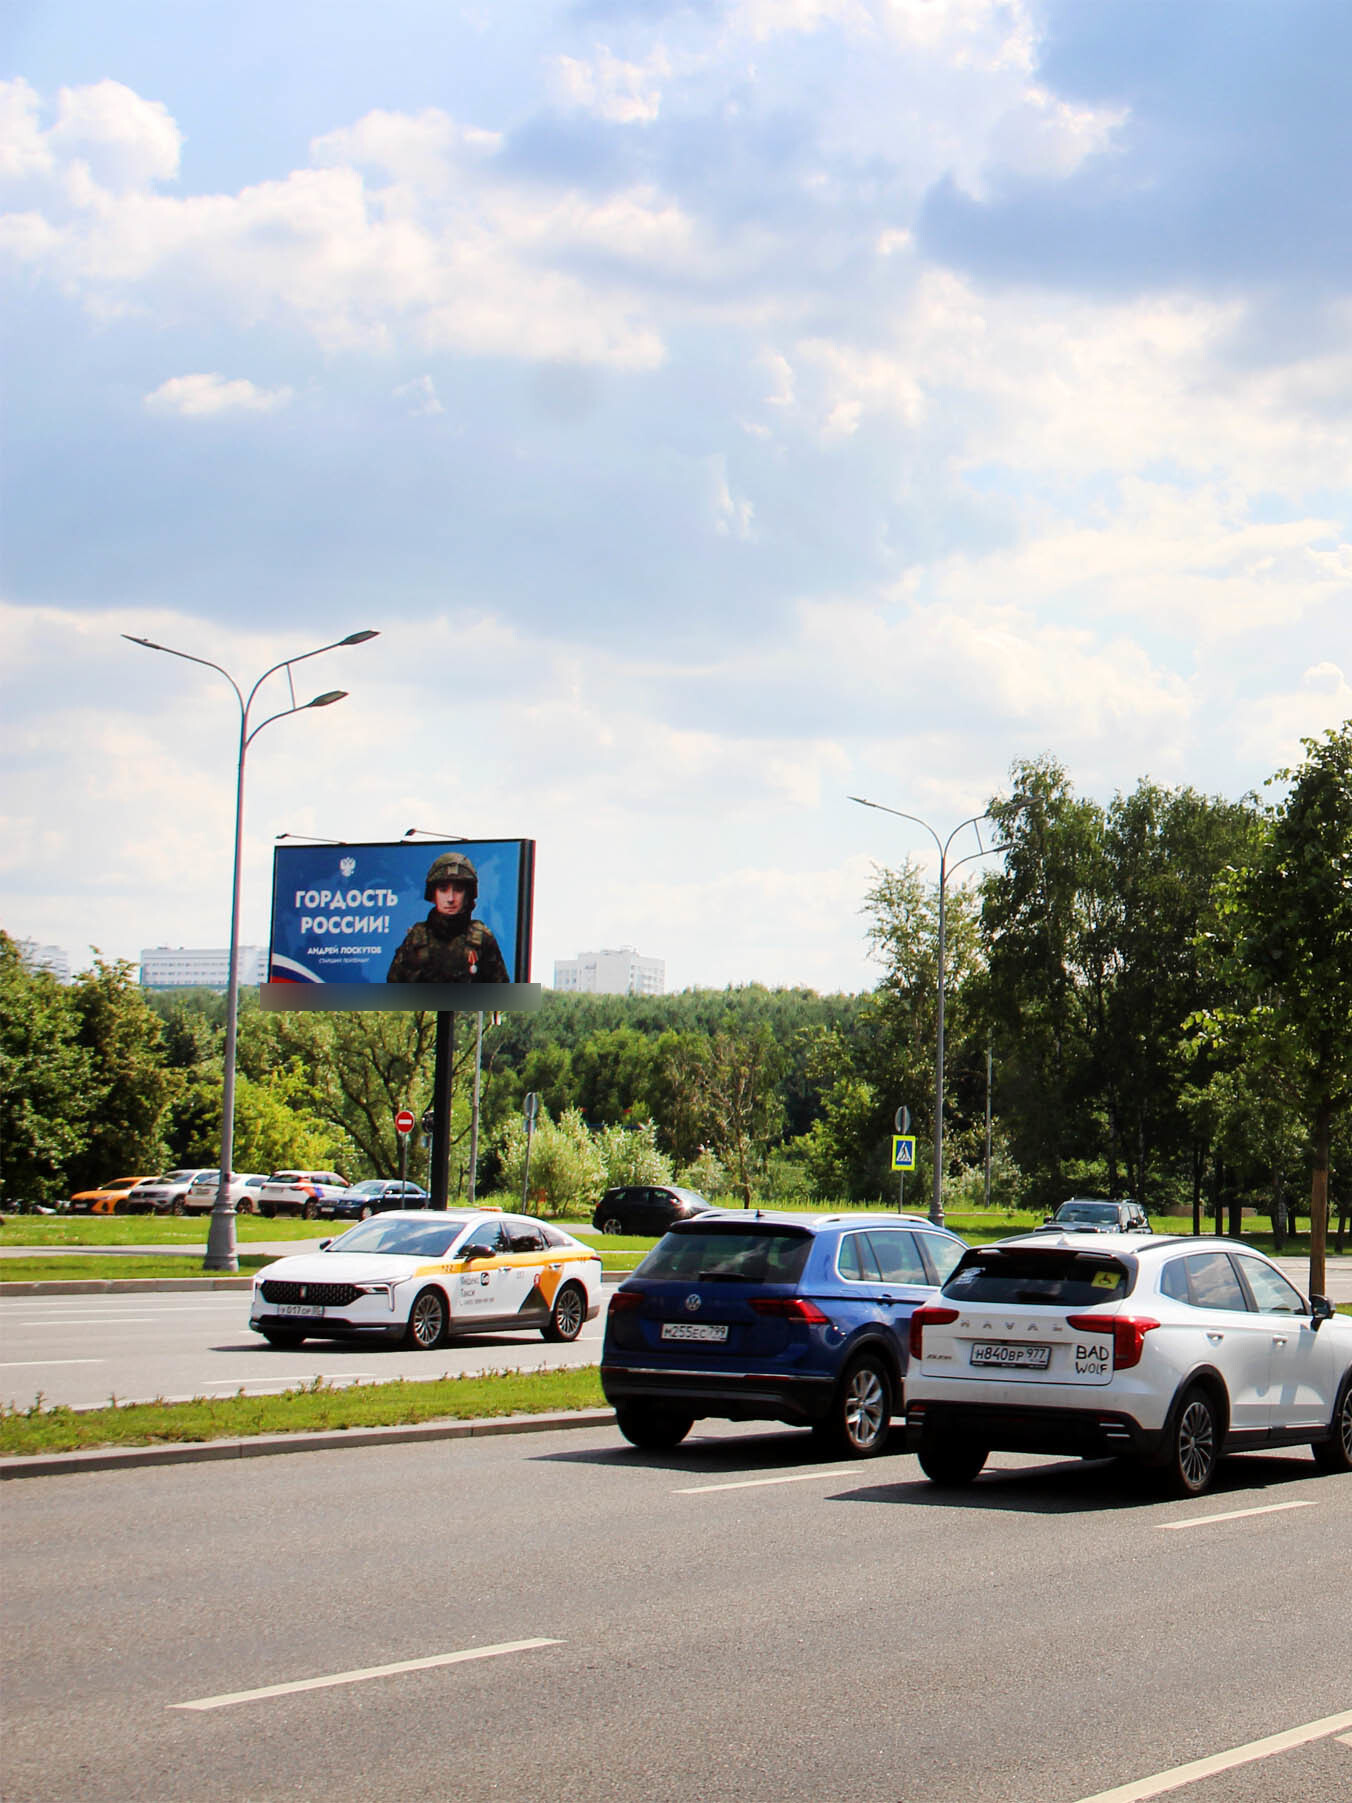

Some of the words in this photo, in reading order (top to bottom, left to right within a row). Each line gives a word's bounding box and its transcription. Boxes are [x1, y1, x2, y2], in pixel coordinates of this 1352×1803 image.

[295, 889, 399, 910] ГОРДОСТЬ
[300, 915, 390, 934] РОССИИ!
[307, 945, 339, 955] АНДРЕЙ
[975, 1346, 1025, 1361] Н840ВР
[1026, 1348, 1047, 1359] 977
[1076, 1344, 1109, 1361] BAD
[1075, 1361, 1108, 1376] WOLF
